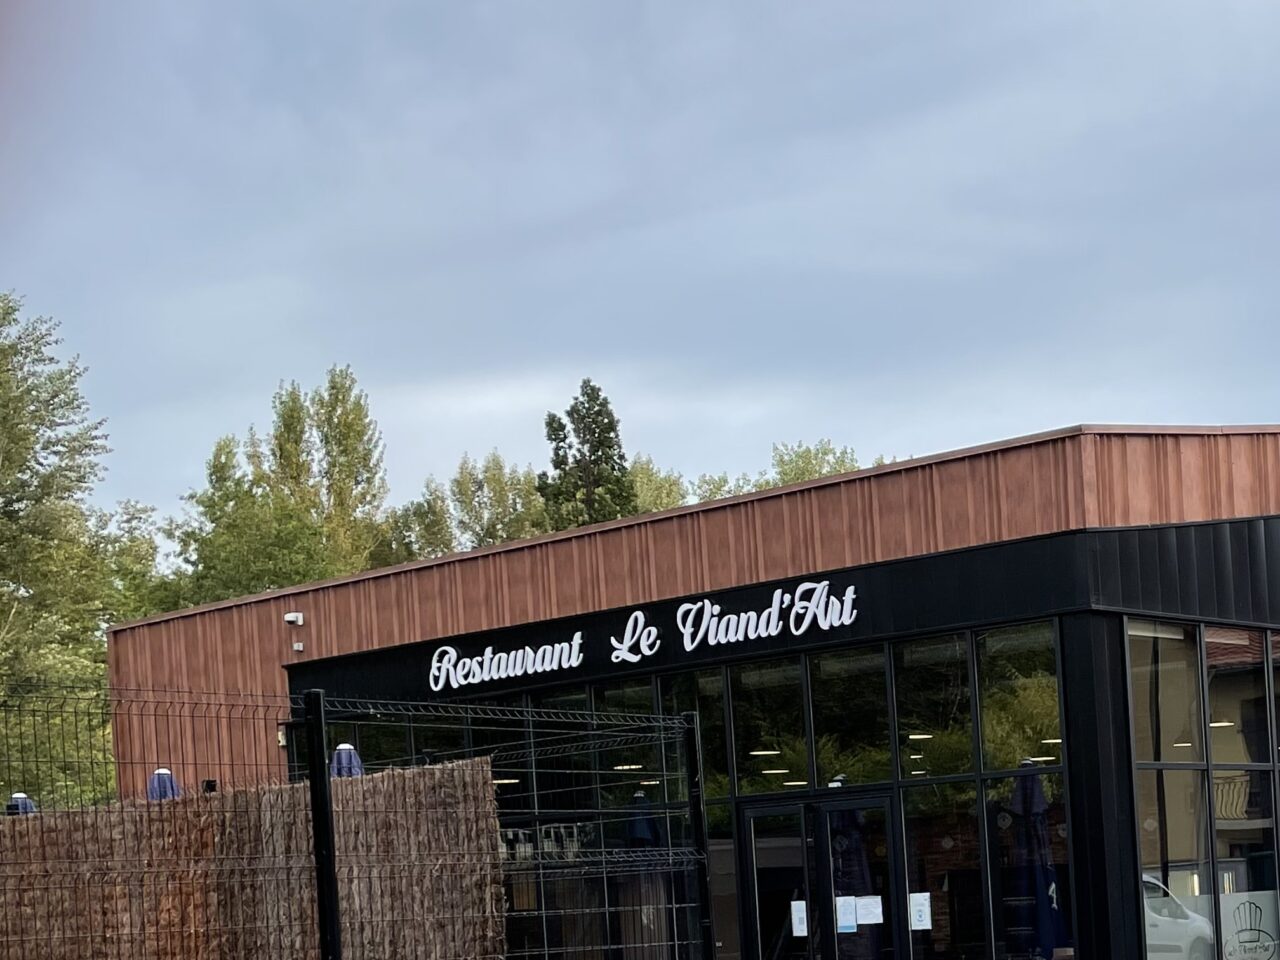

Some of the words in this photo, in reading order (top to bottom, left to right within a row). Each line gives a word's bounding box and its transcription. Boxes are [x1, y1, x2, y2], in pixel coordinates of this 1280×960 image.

[430, 632, 583, 691] Restaurant
[611, 611, 660, 662] Le
[677, 580, 857, 651] Viand'Art
